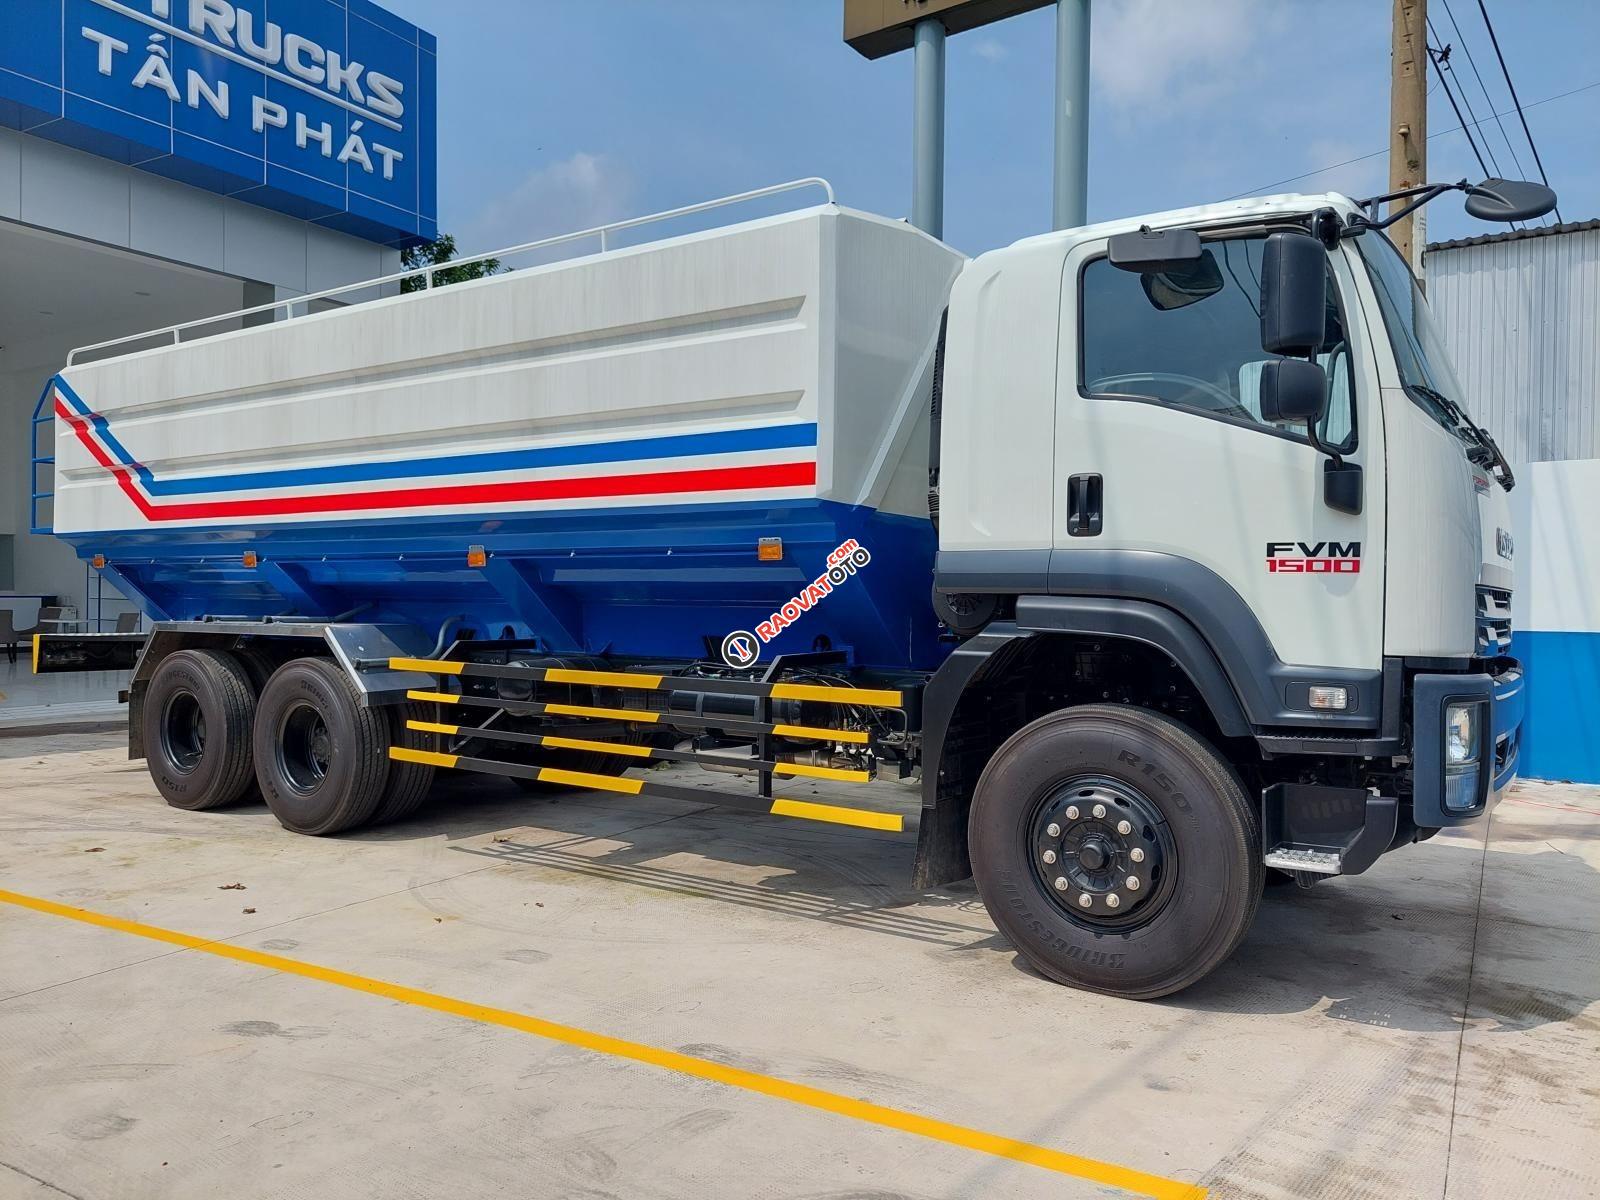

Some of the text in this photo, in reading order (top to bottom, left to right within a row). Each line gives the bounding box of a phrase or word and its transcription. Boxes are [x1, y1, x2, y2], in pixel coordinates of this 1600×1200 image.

[81, 26, 404, 181] TẤN PHÁT
[1266, 541, 1362, 558] FVM
[1266, 559, 1361, 574] 1500
[1117, 749, 1194, 813] R150
[993, 865, 1128, 970] BRIDGESTO
